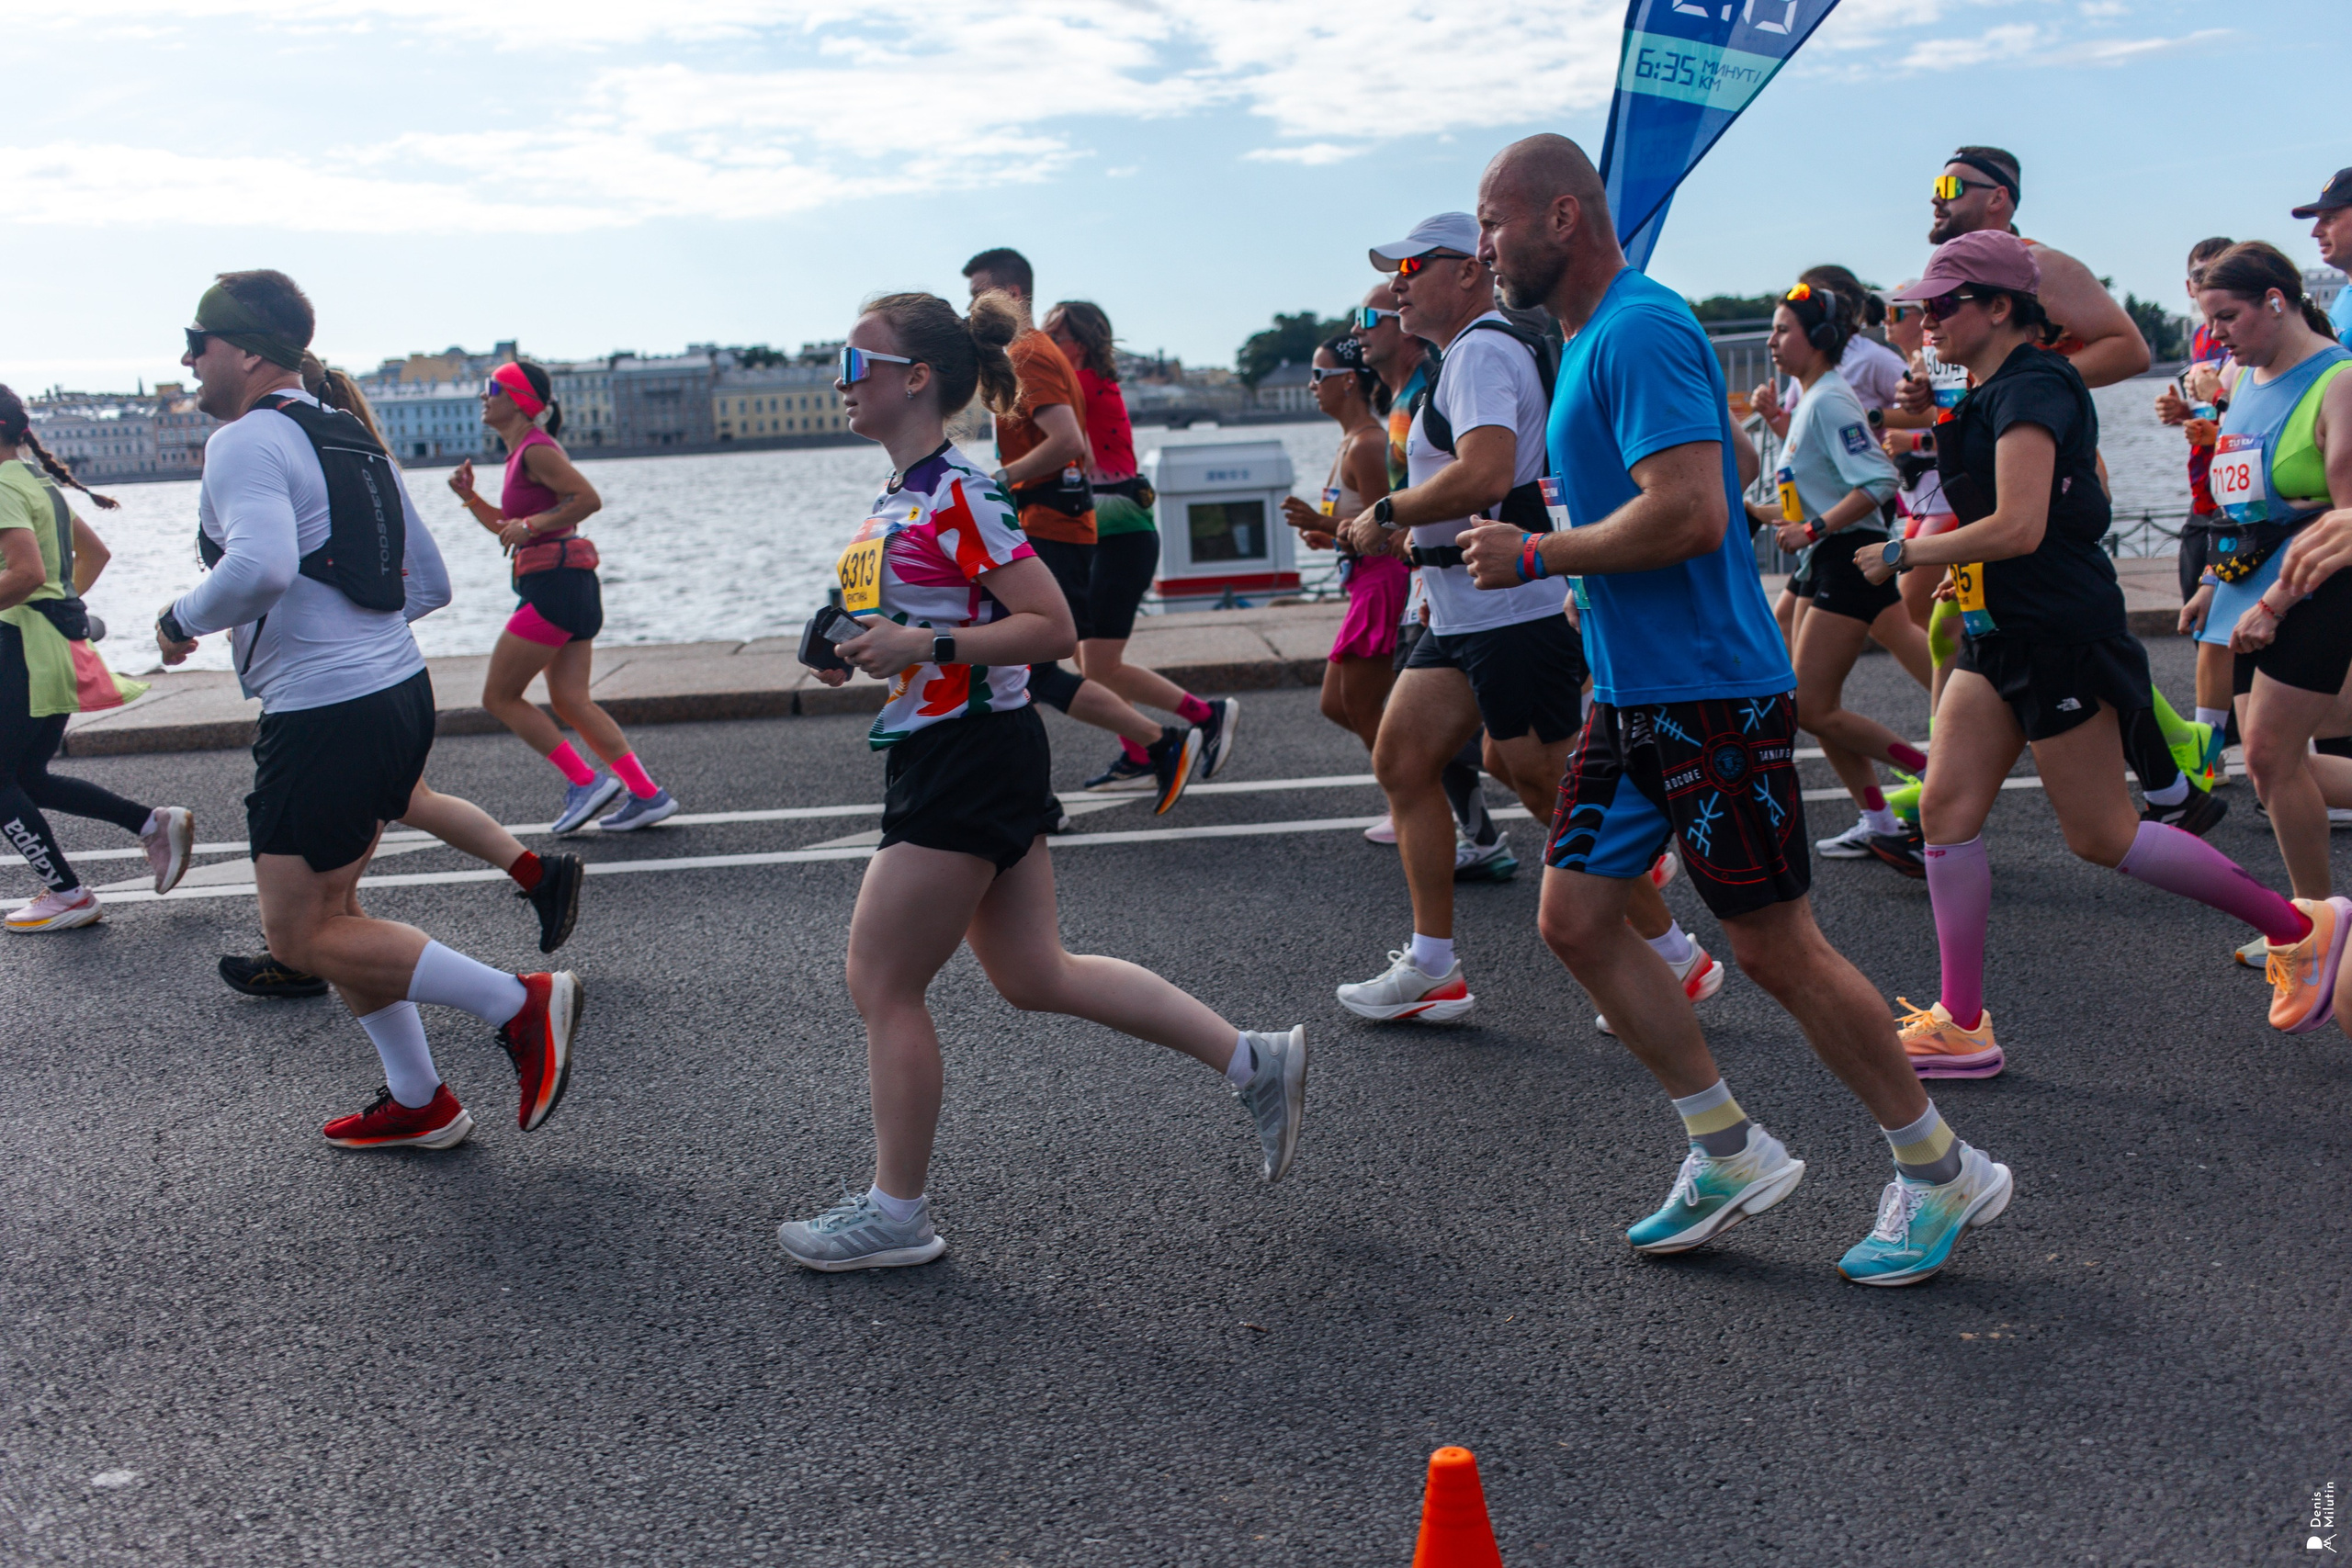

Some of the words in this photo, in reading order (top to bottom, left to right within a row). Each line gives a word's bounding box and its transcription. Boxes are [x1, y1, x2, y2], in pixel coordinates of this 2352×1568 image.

[1635, 48, 1697, 86] 6:35
[1698, 73, 1722, 92] КМ
[2212, 464, 2251, 495] 7128
[841, 549, 876, 591] 6313
